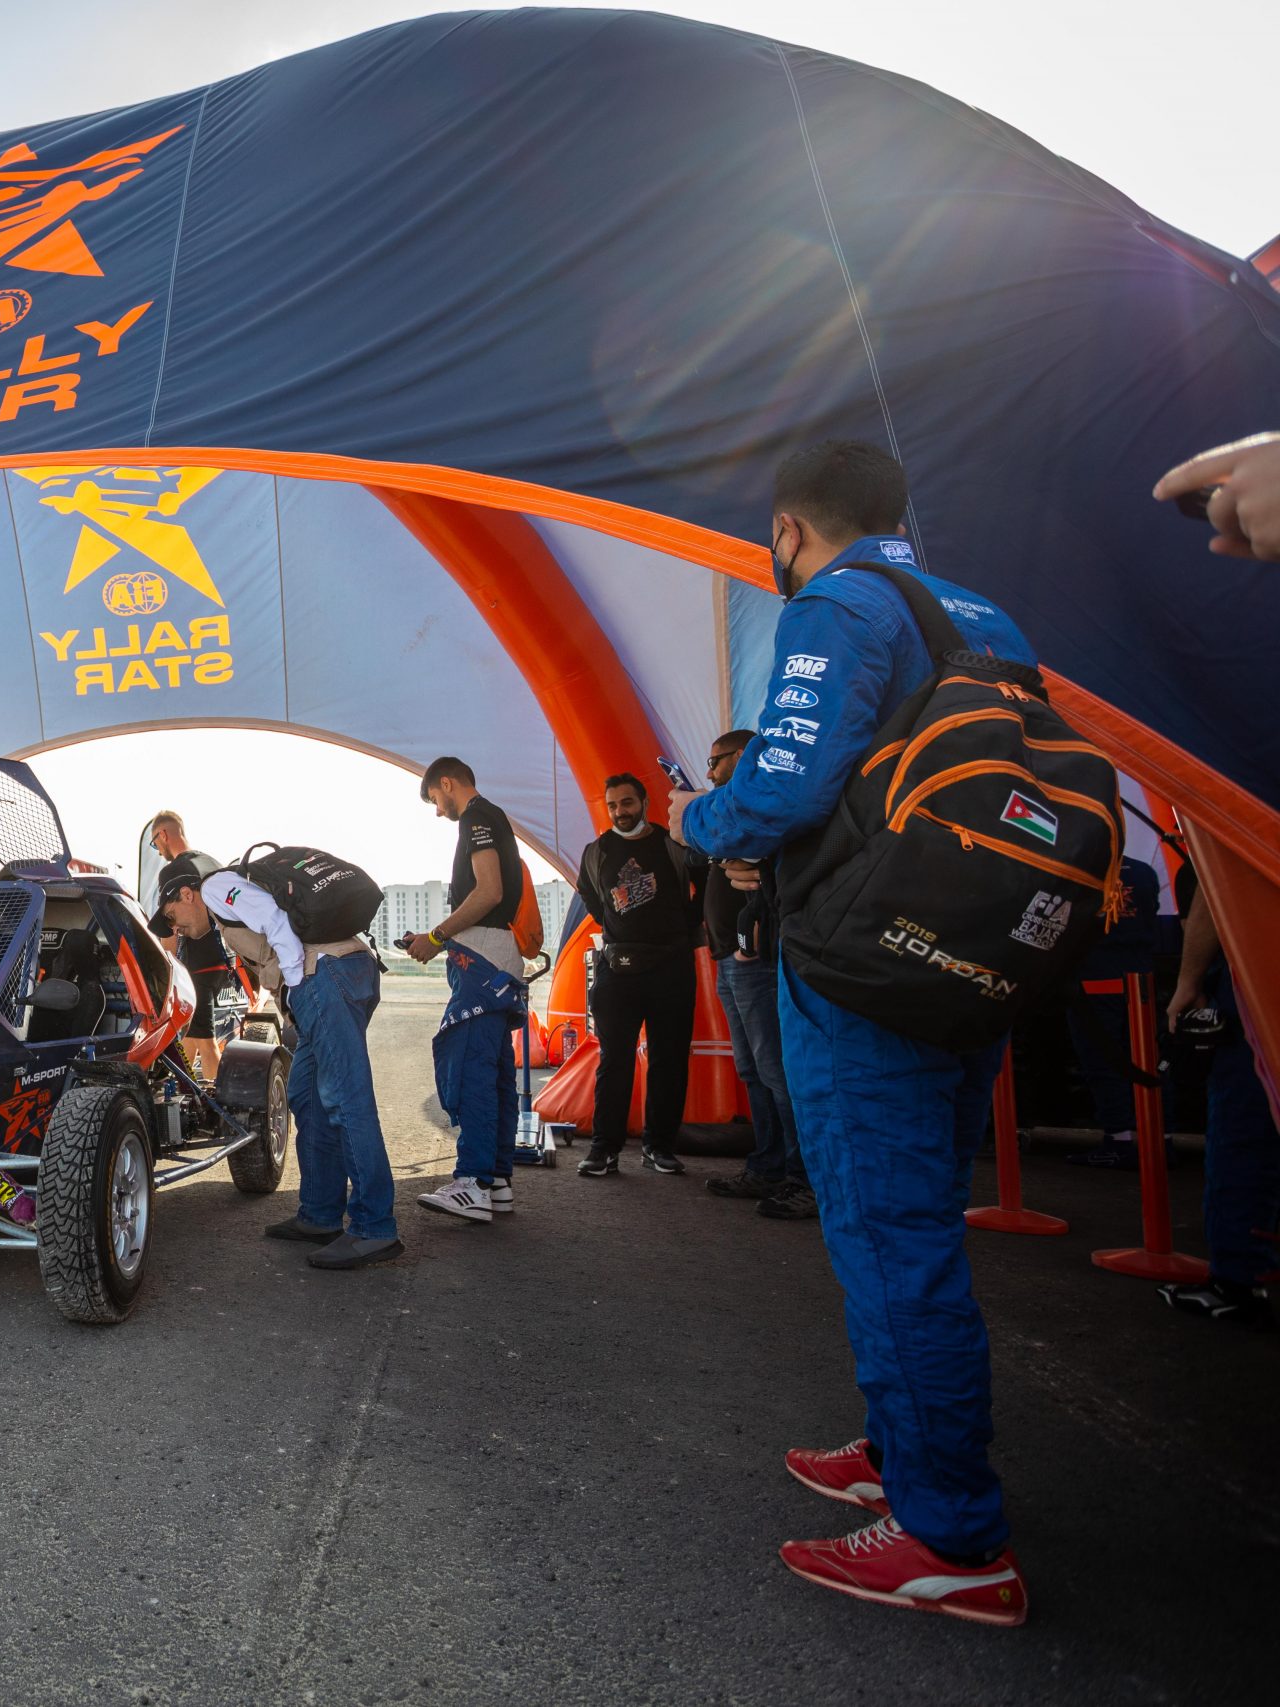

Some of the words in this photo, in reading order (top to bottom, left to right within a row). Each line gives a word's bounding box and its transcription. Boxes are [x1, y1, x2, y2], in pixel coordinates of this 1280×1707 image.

[785, 658, 826, 676] OMP
[778, 758, 806, 772] SAFETY
[894, 916, 937, 942] 2019
[1019, 919, 1061, 942] BAJAS
[884, 931, 1017, 994] JORDAN
[21, 1064, 67, 1086] M-SPORT
